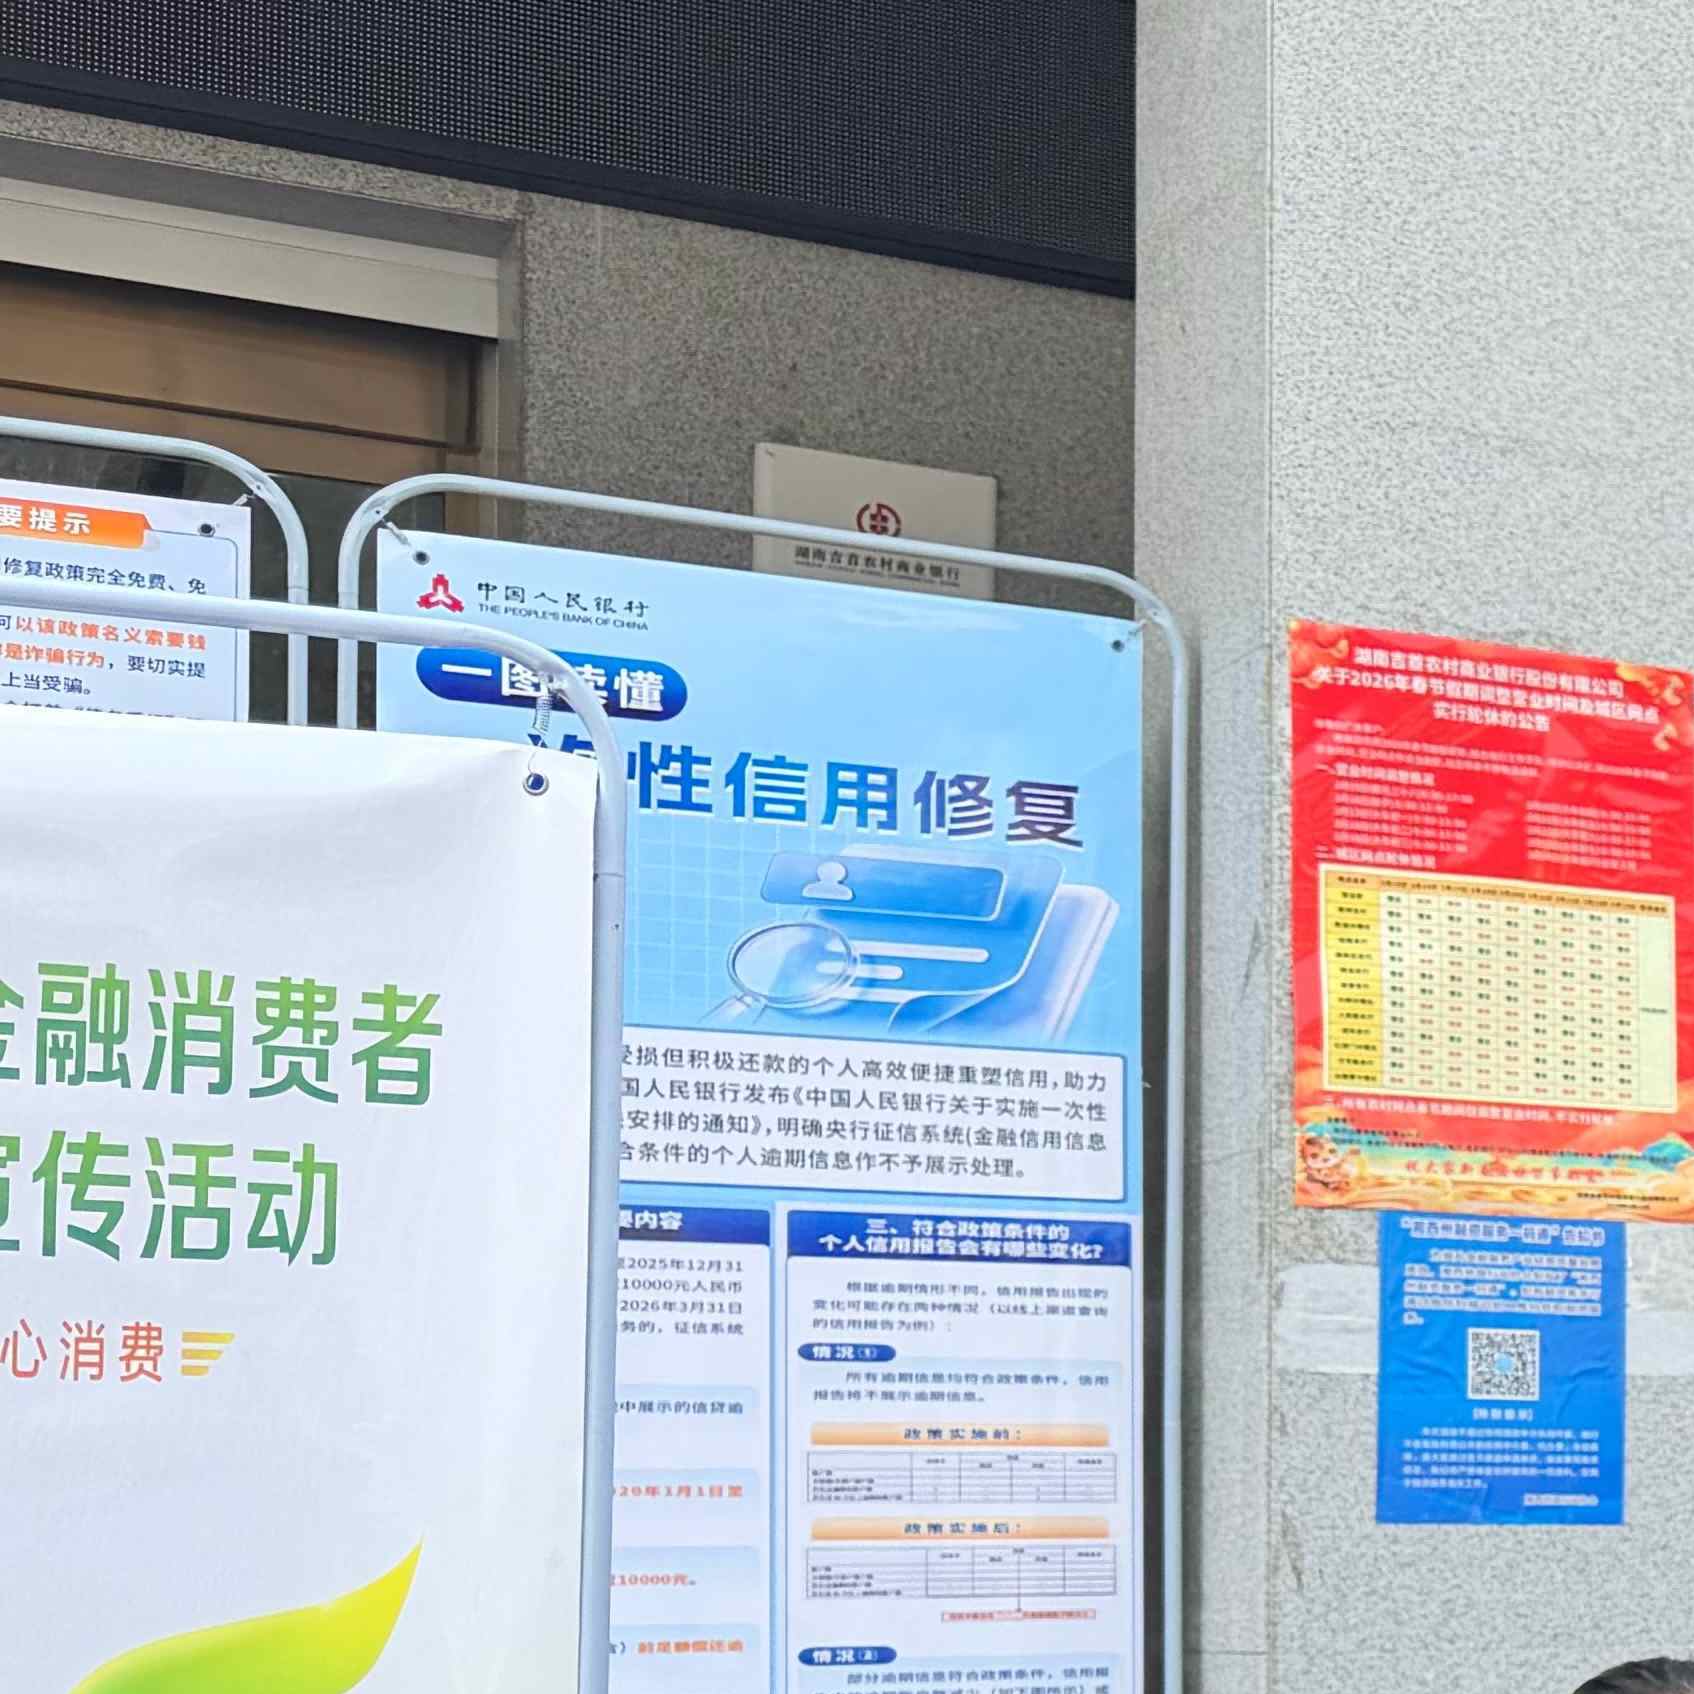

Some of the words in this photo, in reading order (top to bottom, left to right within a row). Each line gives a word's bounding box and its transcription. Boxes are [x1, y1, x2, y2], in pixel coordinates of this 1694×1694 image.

[477, 582, 649, 617] 中国人民银行
[0, 962, 443, 1106] 融消费者
[0, 1130, 339, 1267] 传活动
